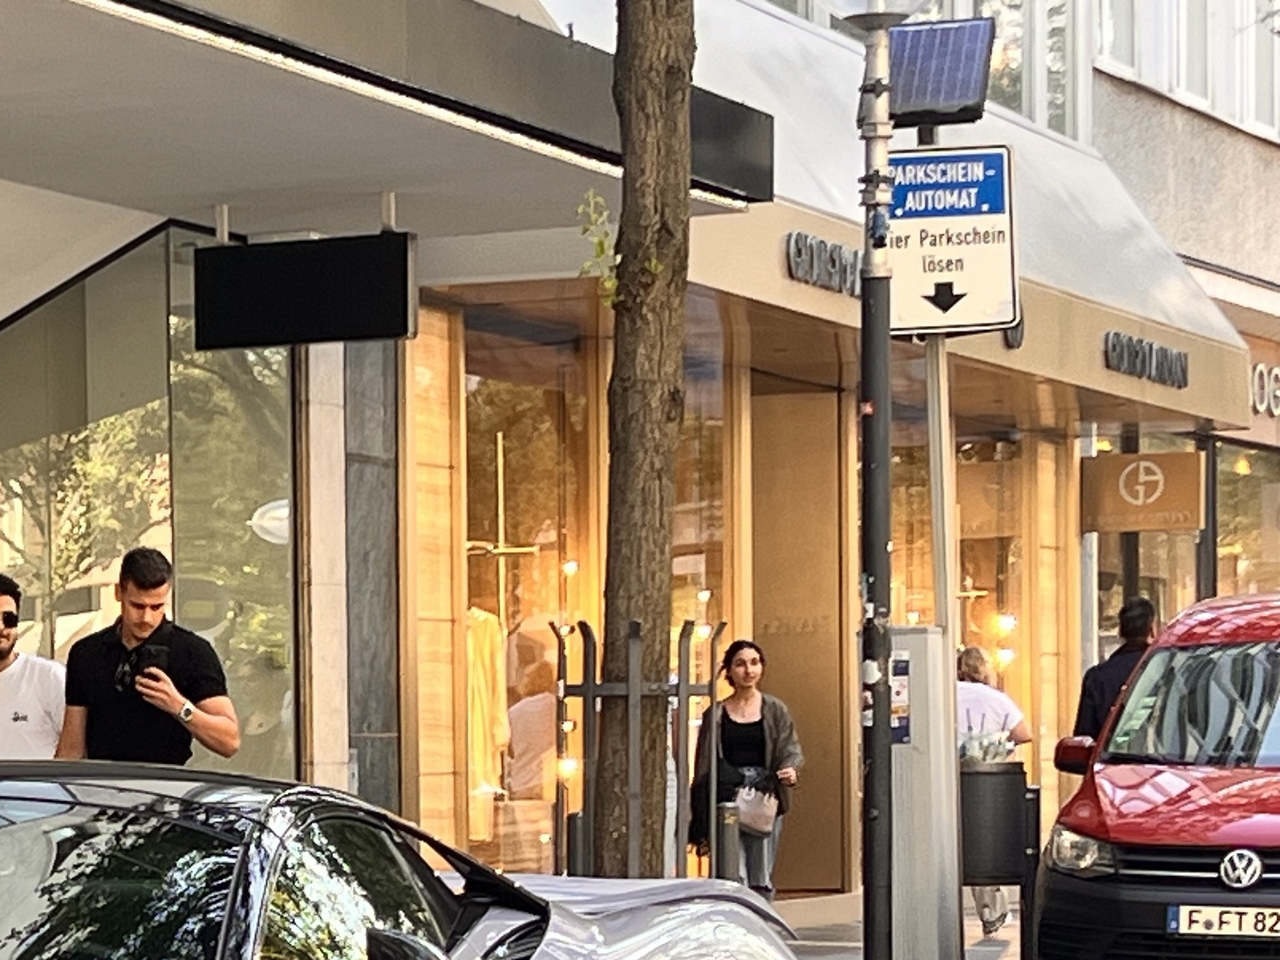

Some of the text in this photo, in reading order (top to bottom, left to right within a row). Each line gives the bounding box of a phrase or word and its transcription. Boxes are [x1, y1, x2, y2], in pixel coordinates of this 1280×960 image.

[905, 188, 979, 212] AUTOMAT
[889, 225, 1007, 249] ier Parkschein
[922, 256, 964, 273] lösen
